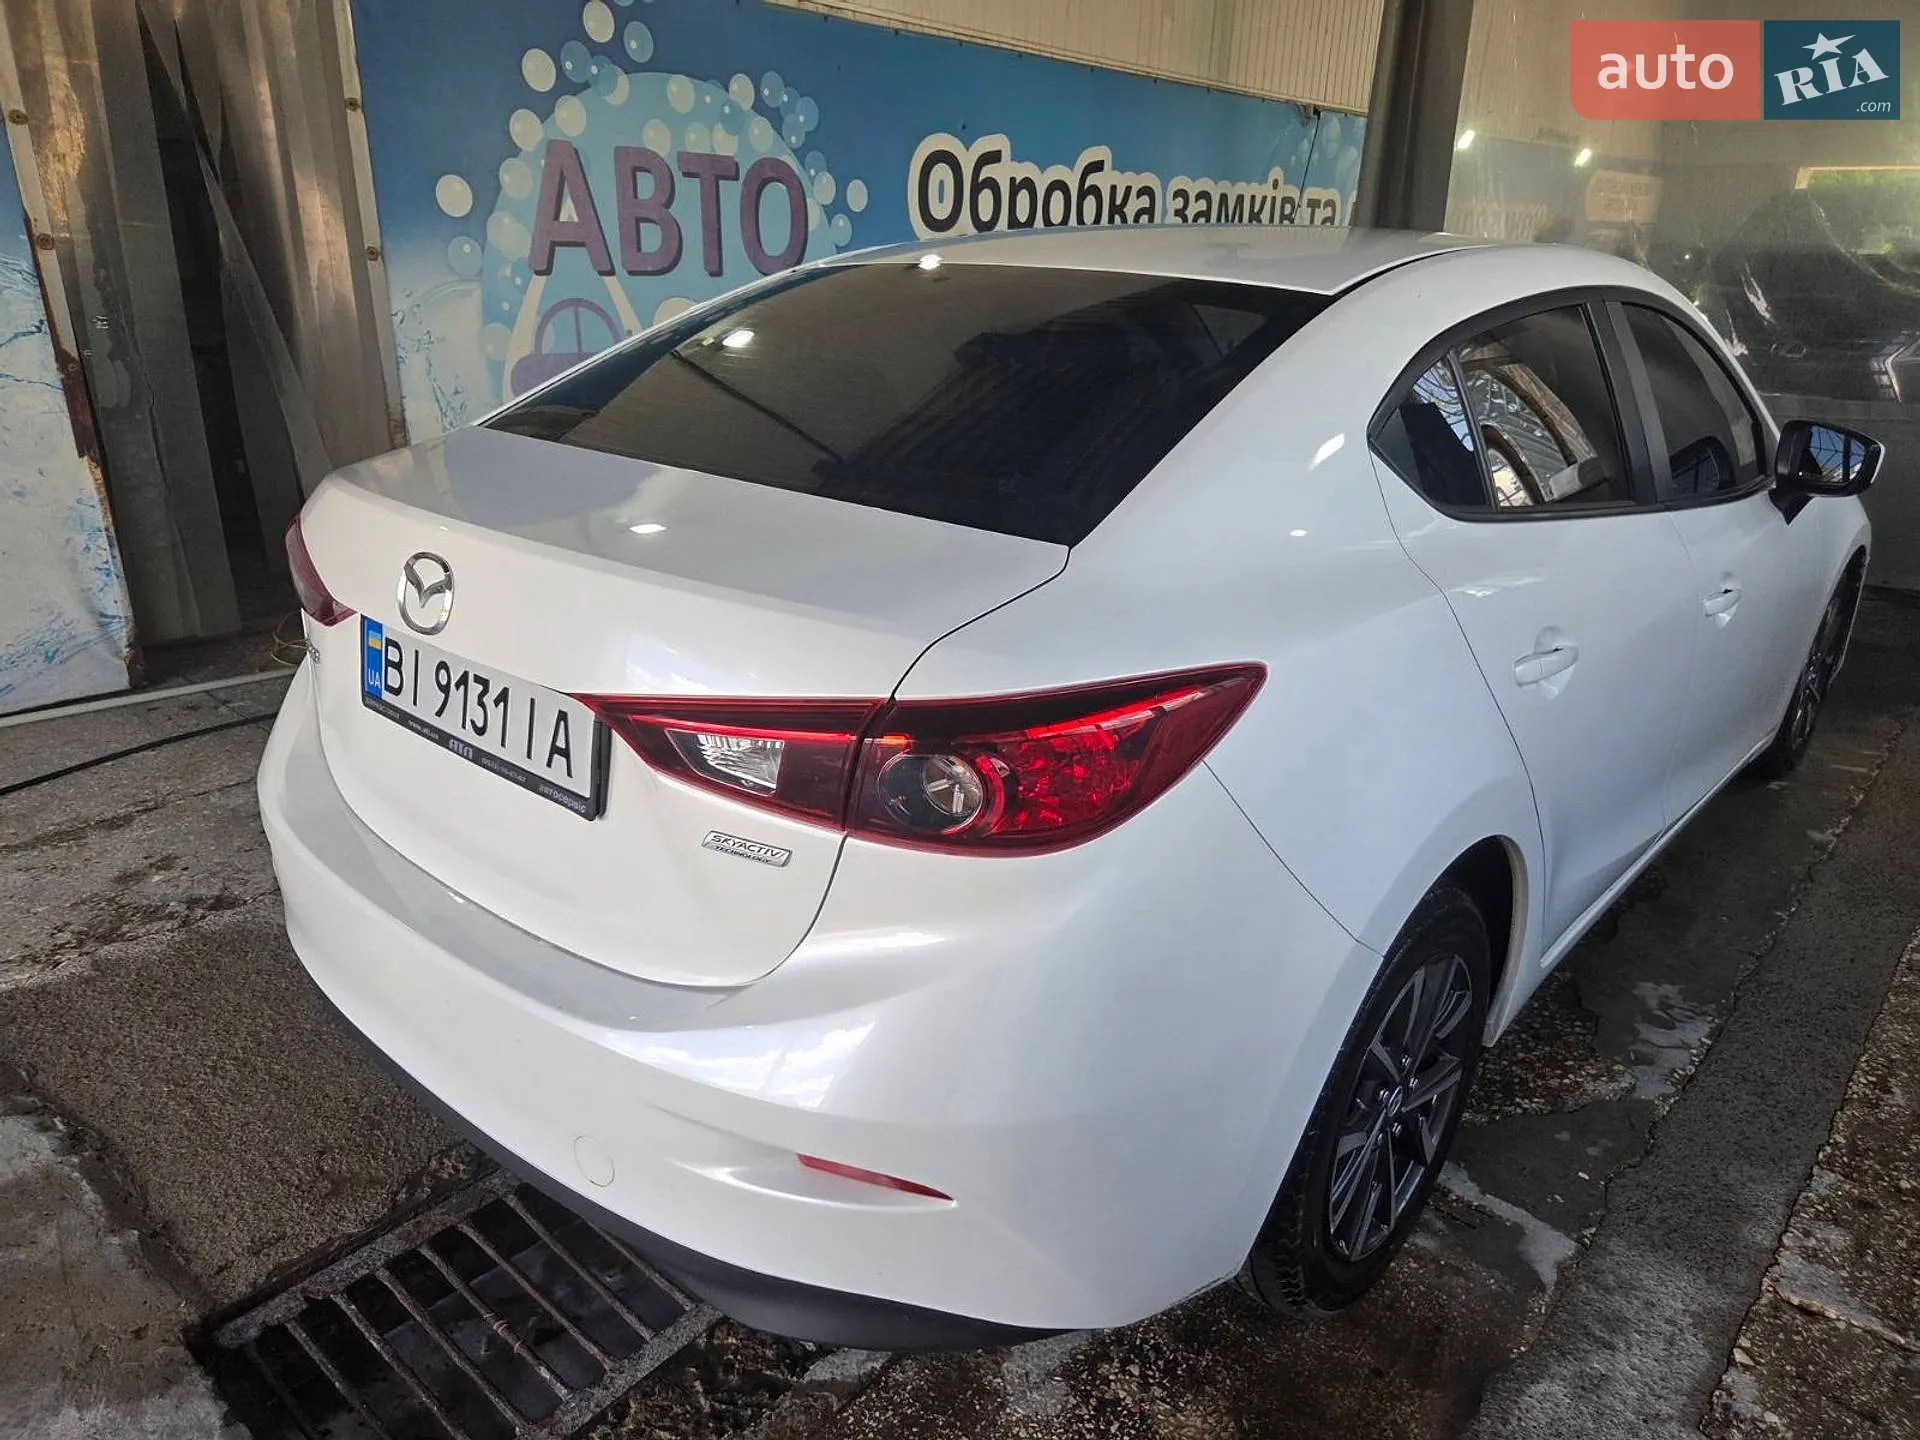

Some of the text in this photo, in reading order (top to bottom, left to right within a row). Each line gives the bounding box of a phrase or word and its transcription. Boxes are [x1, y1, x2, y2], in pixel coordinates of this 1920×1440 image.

[529, 138, 809, 277] АВТО
[916, 148, 1155, 233] Обробка
[1172, 178, 1296, 225] замків
[1306, 198, 1337, 226] та
[368, 667, 382, 690] UA
[435, 660, 510, 749] 9131
[526, 697, 574, 778] IA
[711, 834, 783, 857] SKYACTIV
